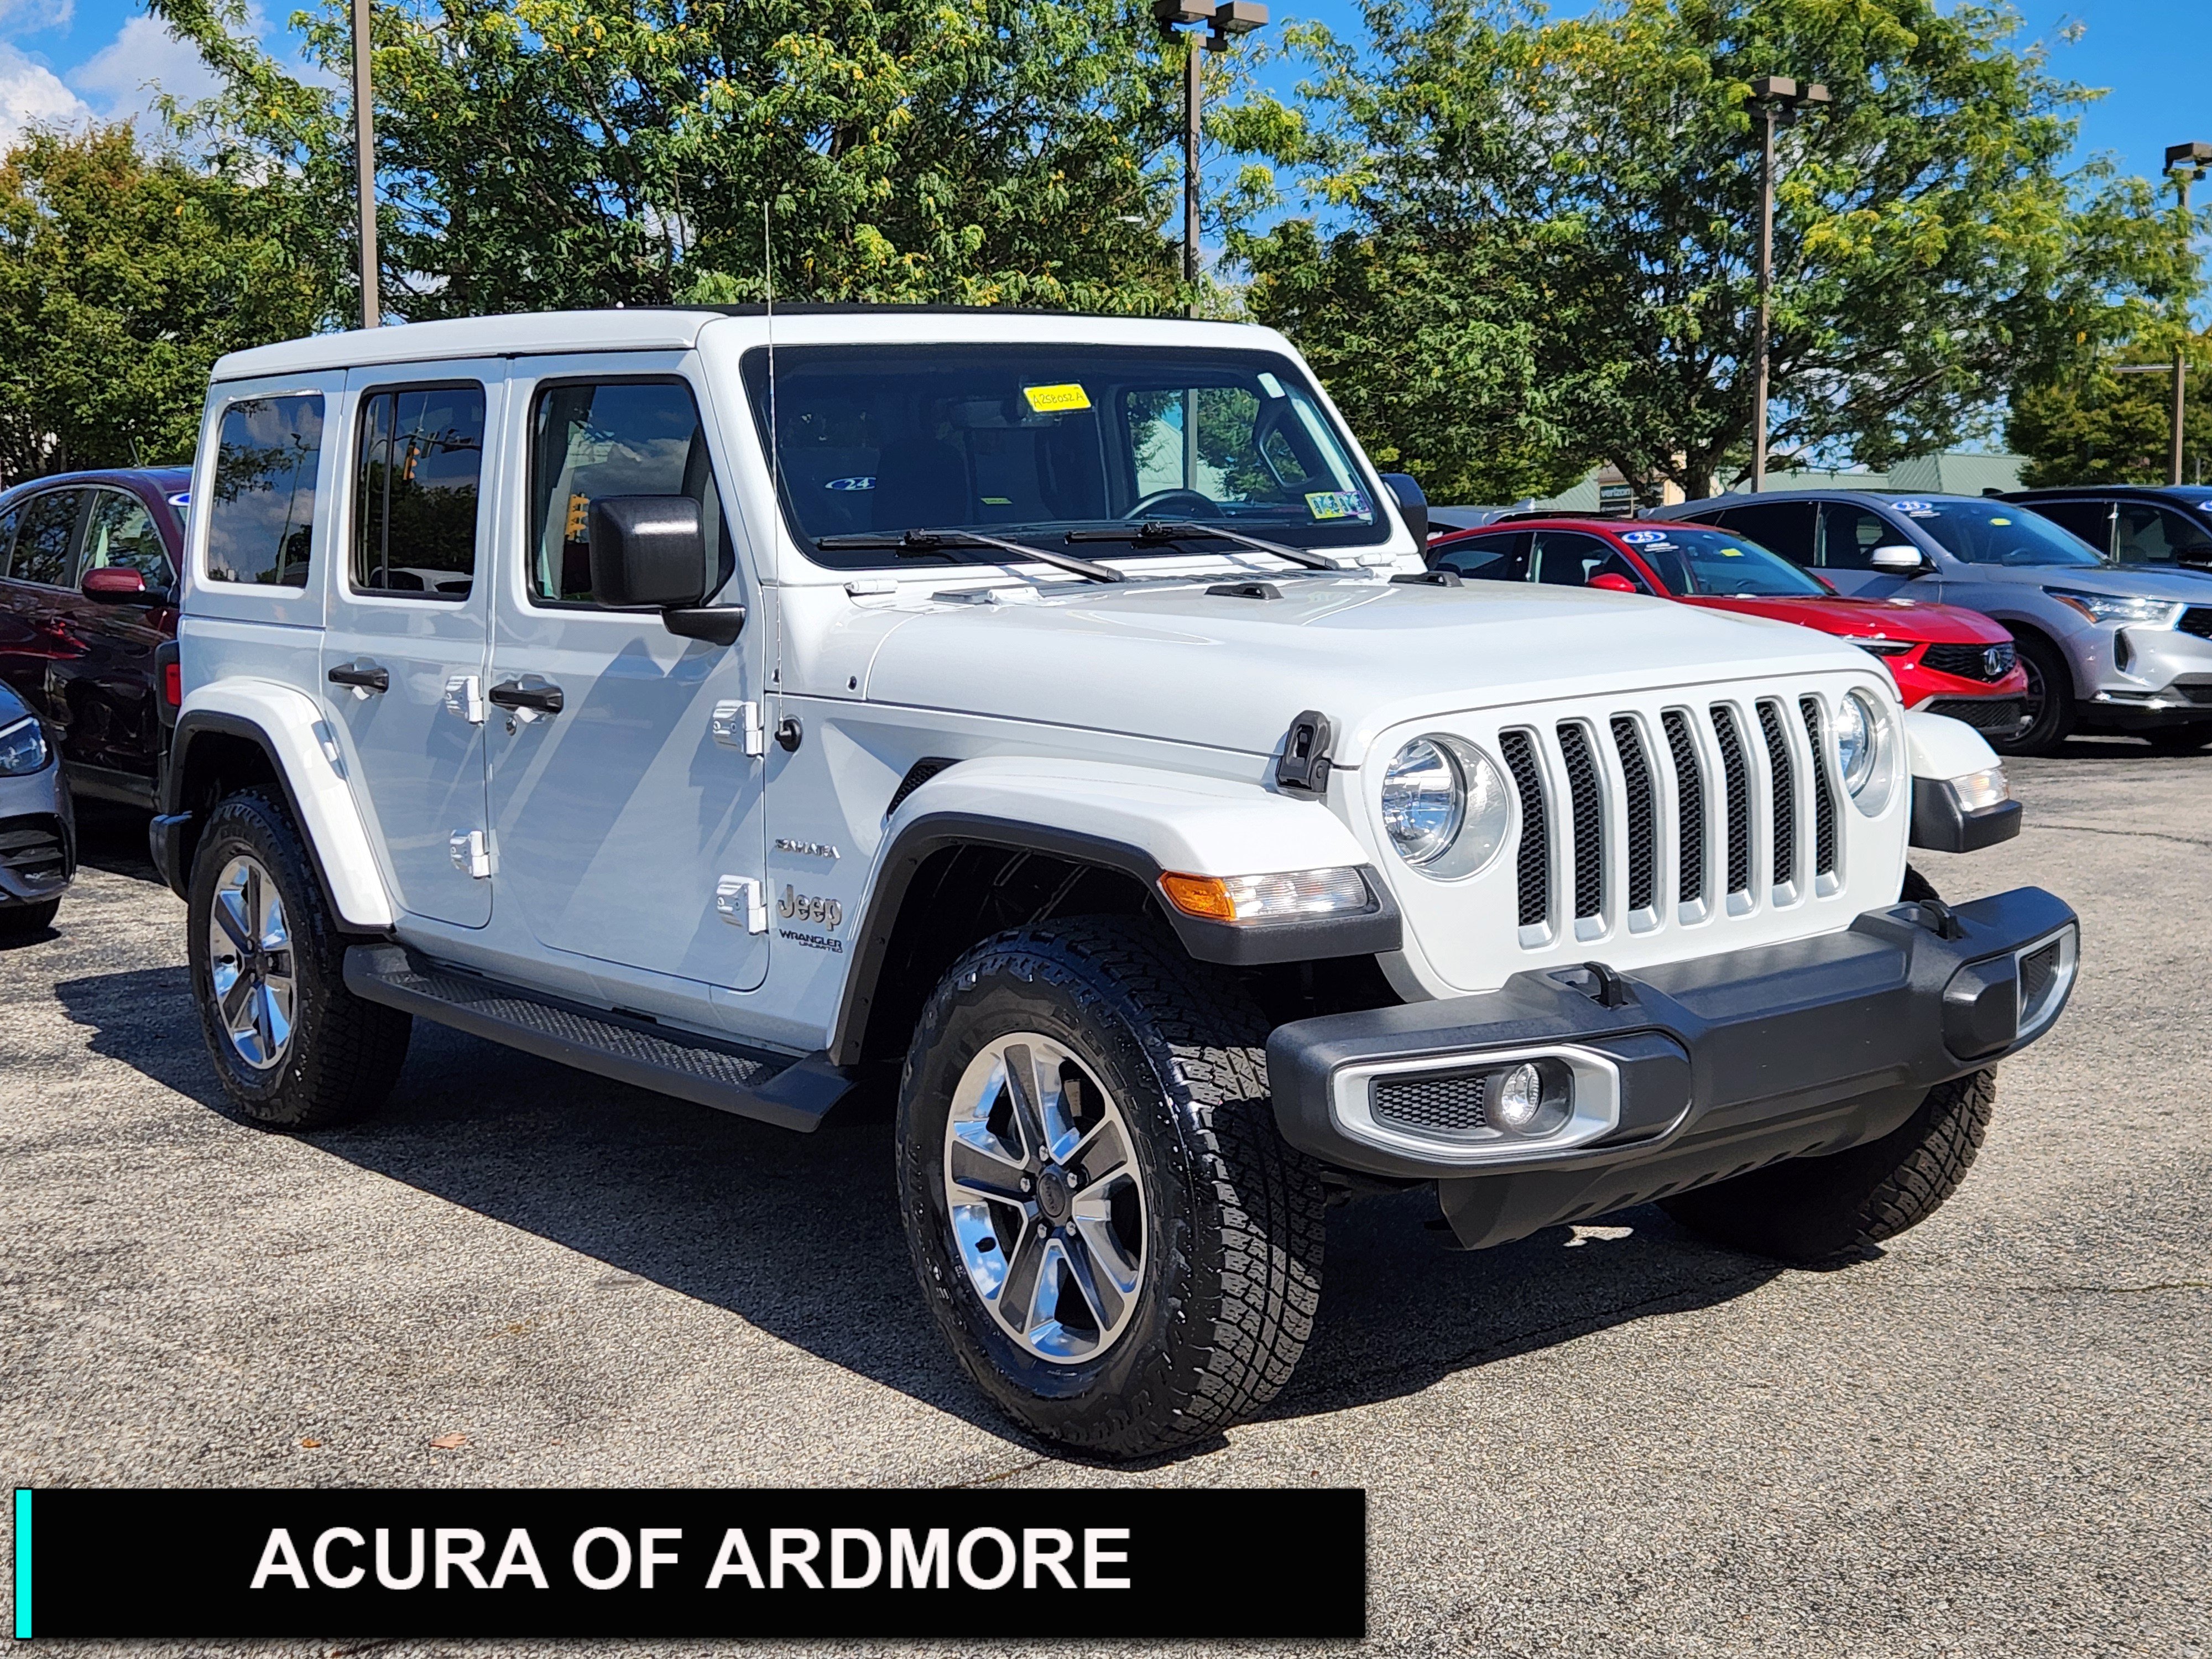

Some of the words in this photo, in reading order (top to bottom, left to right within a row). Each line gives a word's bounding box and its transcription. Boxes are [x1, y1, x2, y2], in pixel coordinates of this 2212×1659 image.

[1032, 392, 1085, 408] A258052A
[844, 477, 870, 490] 24
[1634, 531, 1654, 542] 25
[777, 884, 842, 932] Jeep
[779, 928, 842, 948] WRANGLER
[799, 941, 843, 953] UNLIMITED
